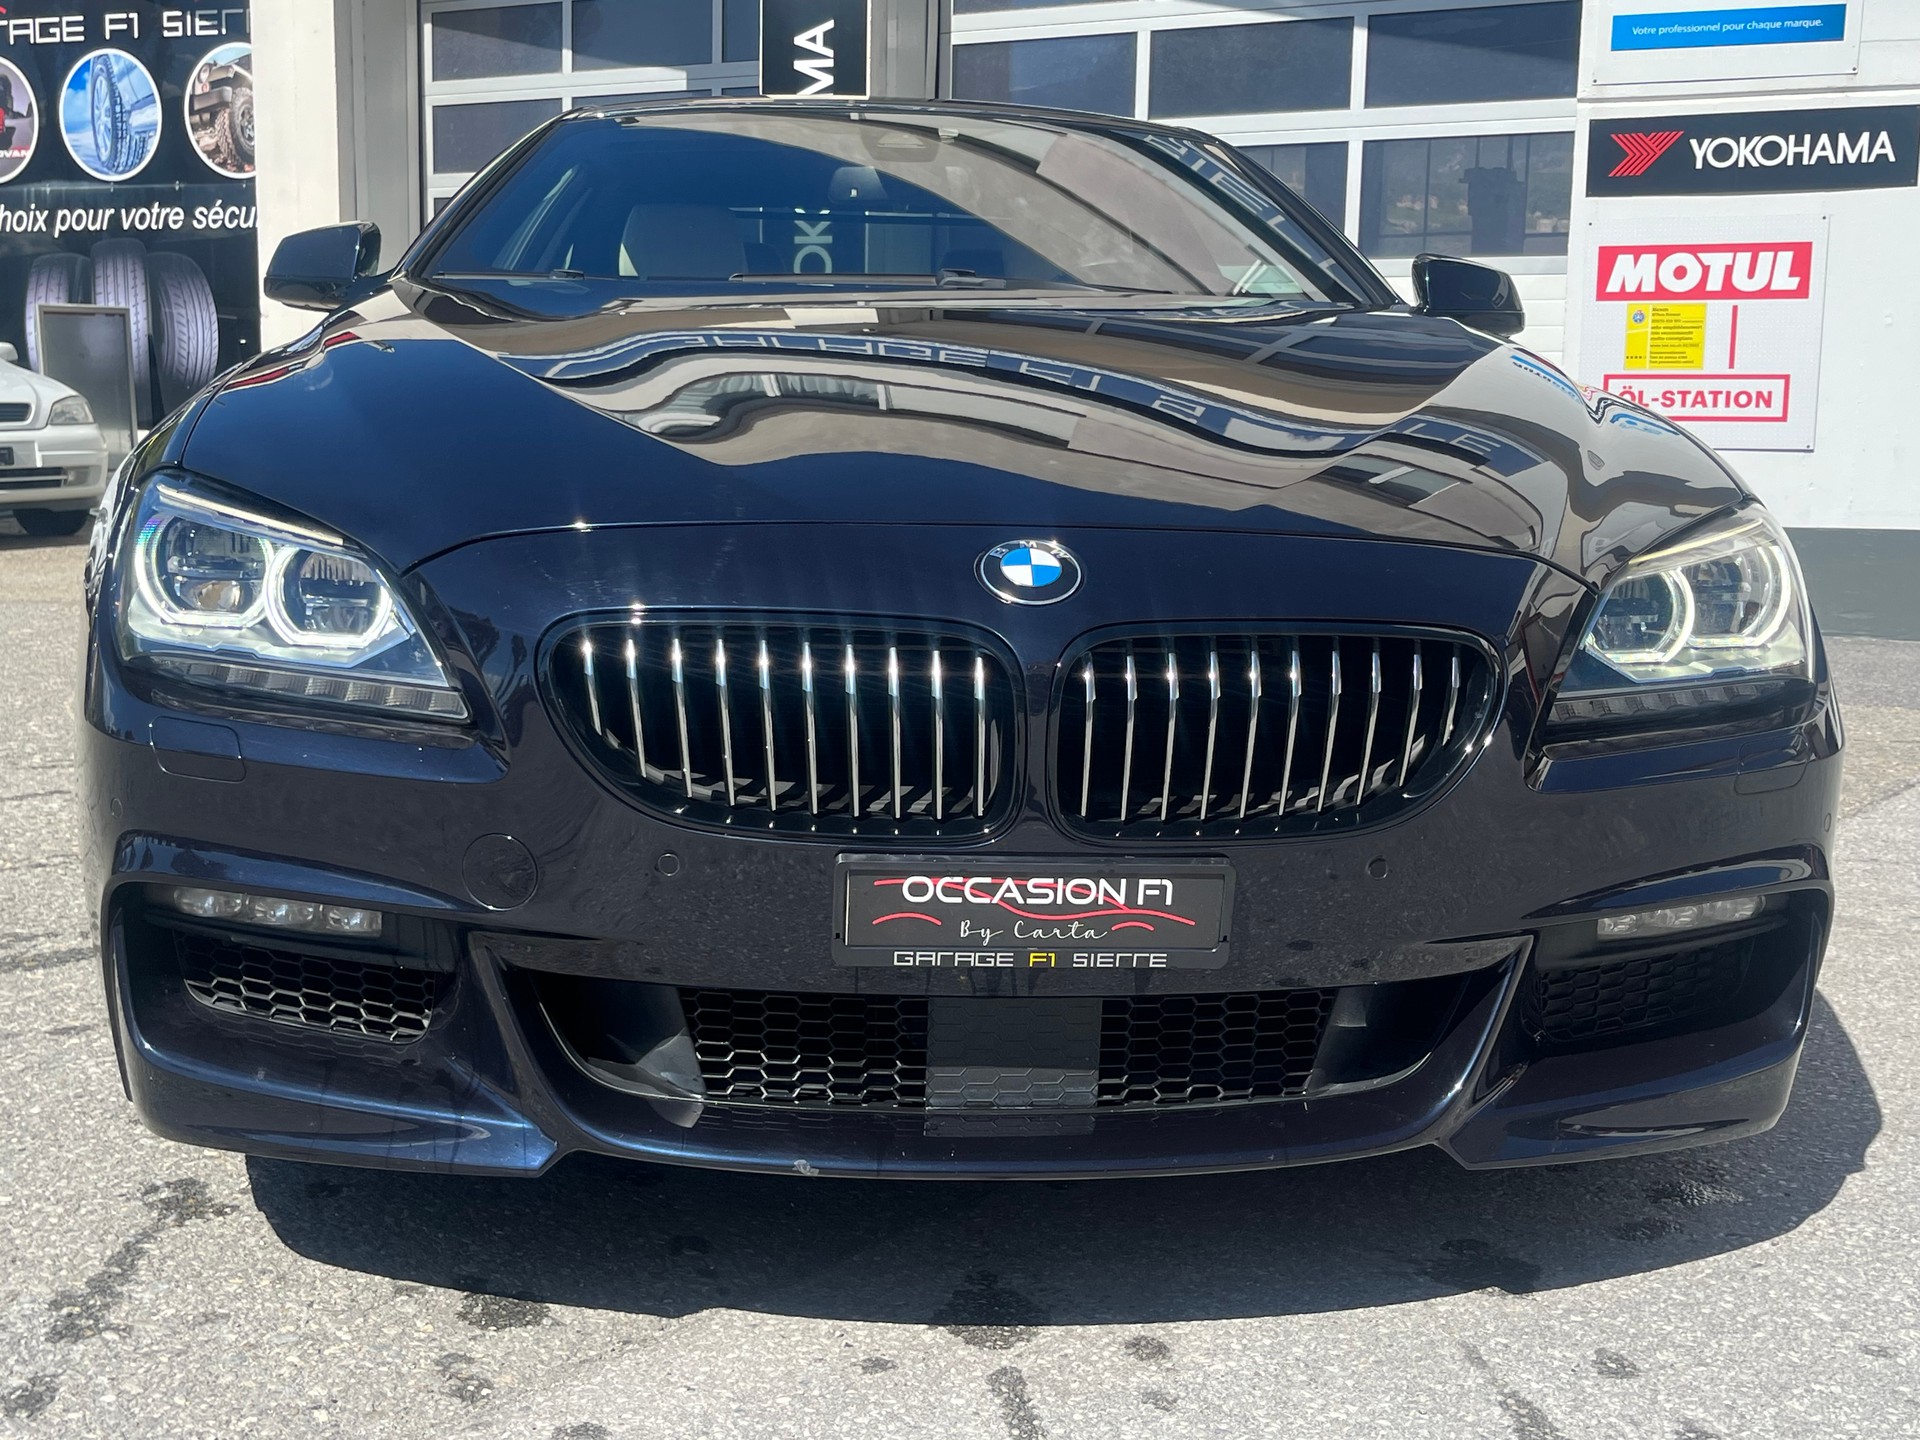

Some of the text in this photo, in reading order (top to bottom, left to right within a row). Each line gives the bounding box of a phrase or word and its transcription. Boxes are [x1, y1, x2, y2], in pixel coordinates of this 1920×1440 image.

[104, 12, 140, 41] F1
[1631, 25, 1657, 35] Votre
[1658, 22, 1721, 36] professionnel
[1722, 22, 1746, 32] pour
[1746, 20, 1783, 31] chaque
[1689, 130, 1897, 170] YOKOHAMA
[54, 208, 115, 239] pour
[121, 201, 185, 231] votre
[192, 199, 259, 230] sécu
[1605, 251, 1801, 293] MOTUL
[1618, 385, 1774, 409] ÖL-STATION
[989, 540, 1070, 559] BMW
[902, 875, 1173, 906] OCCASION F1
[960, 919, 1108, 946] By Carta
[1029, 952, 1056, 968] F1
